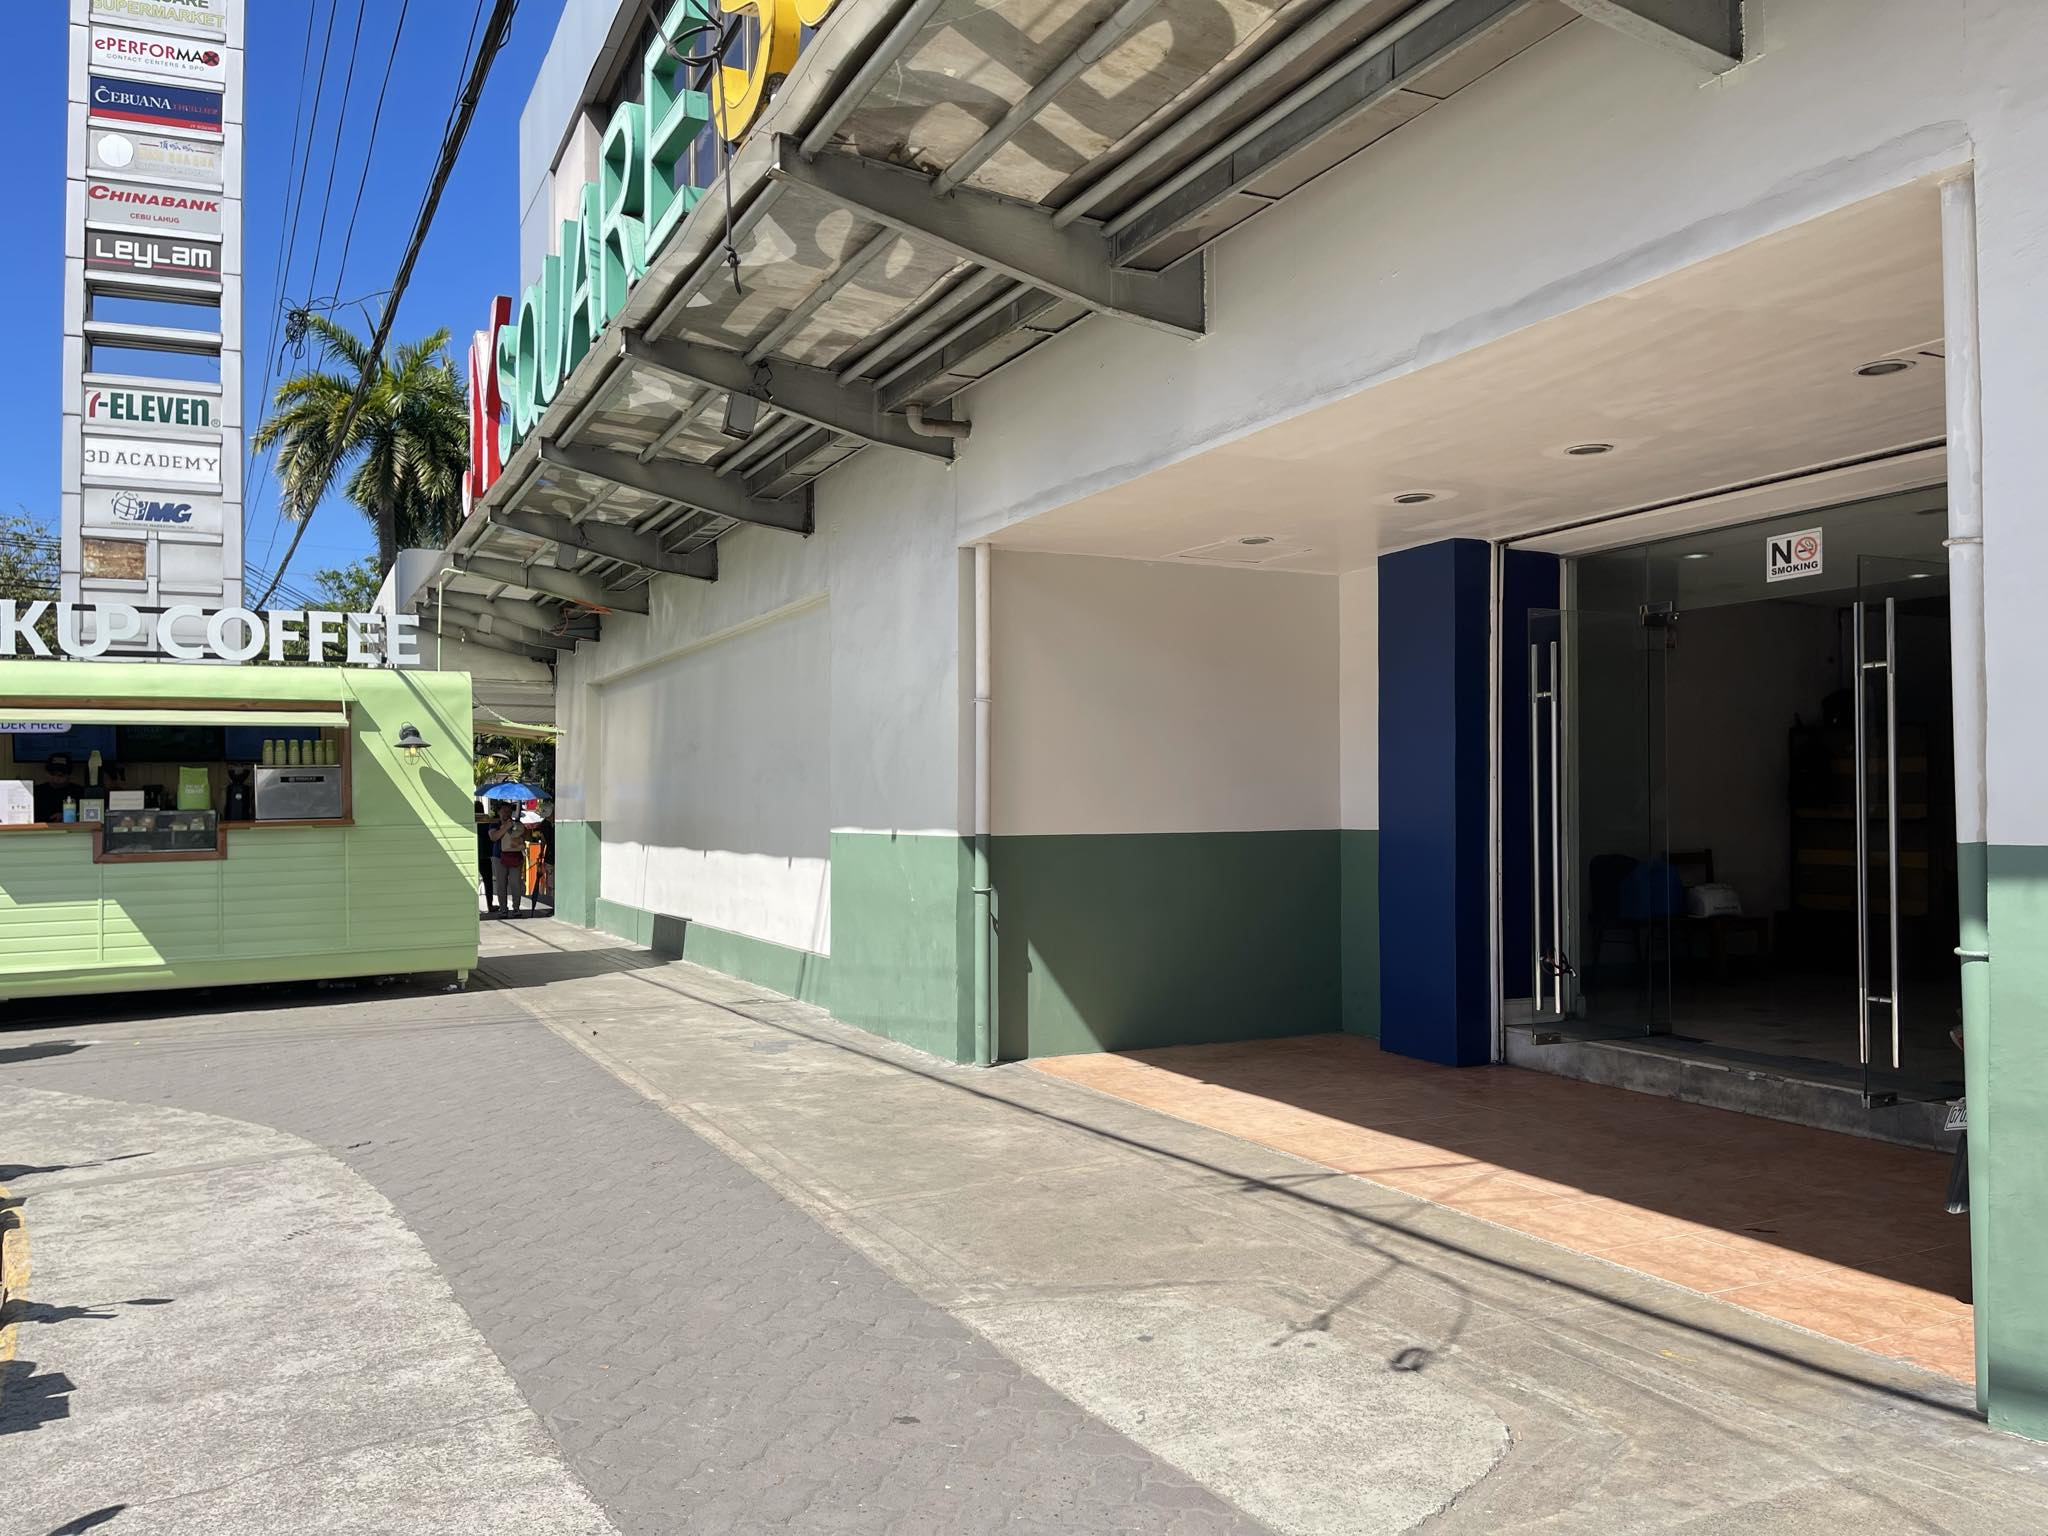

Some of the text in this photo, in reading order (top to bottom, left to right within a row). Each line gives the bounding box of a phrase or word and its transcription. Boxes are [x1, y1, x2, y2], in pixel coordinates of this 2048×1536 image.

[93, 0, 225, 28] SUPERMARKET
[106, 53, 142, 63] CONTACT
[144, 58, 179, 69] CENTERS
[88, 185, 220, 213] CHINABANK
[130, 212, 180, 224] CEBU LAHUG
[85, 449, 218, 472] 3D ACADEMY
[1771, 561, 1818, 575] SMOKING
[0, 599, 420, 664] KUP COFFEE
